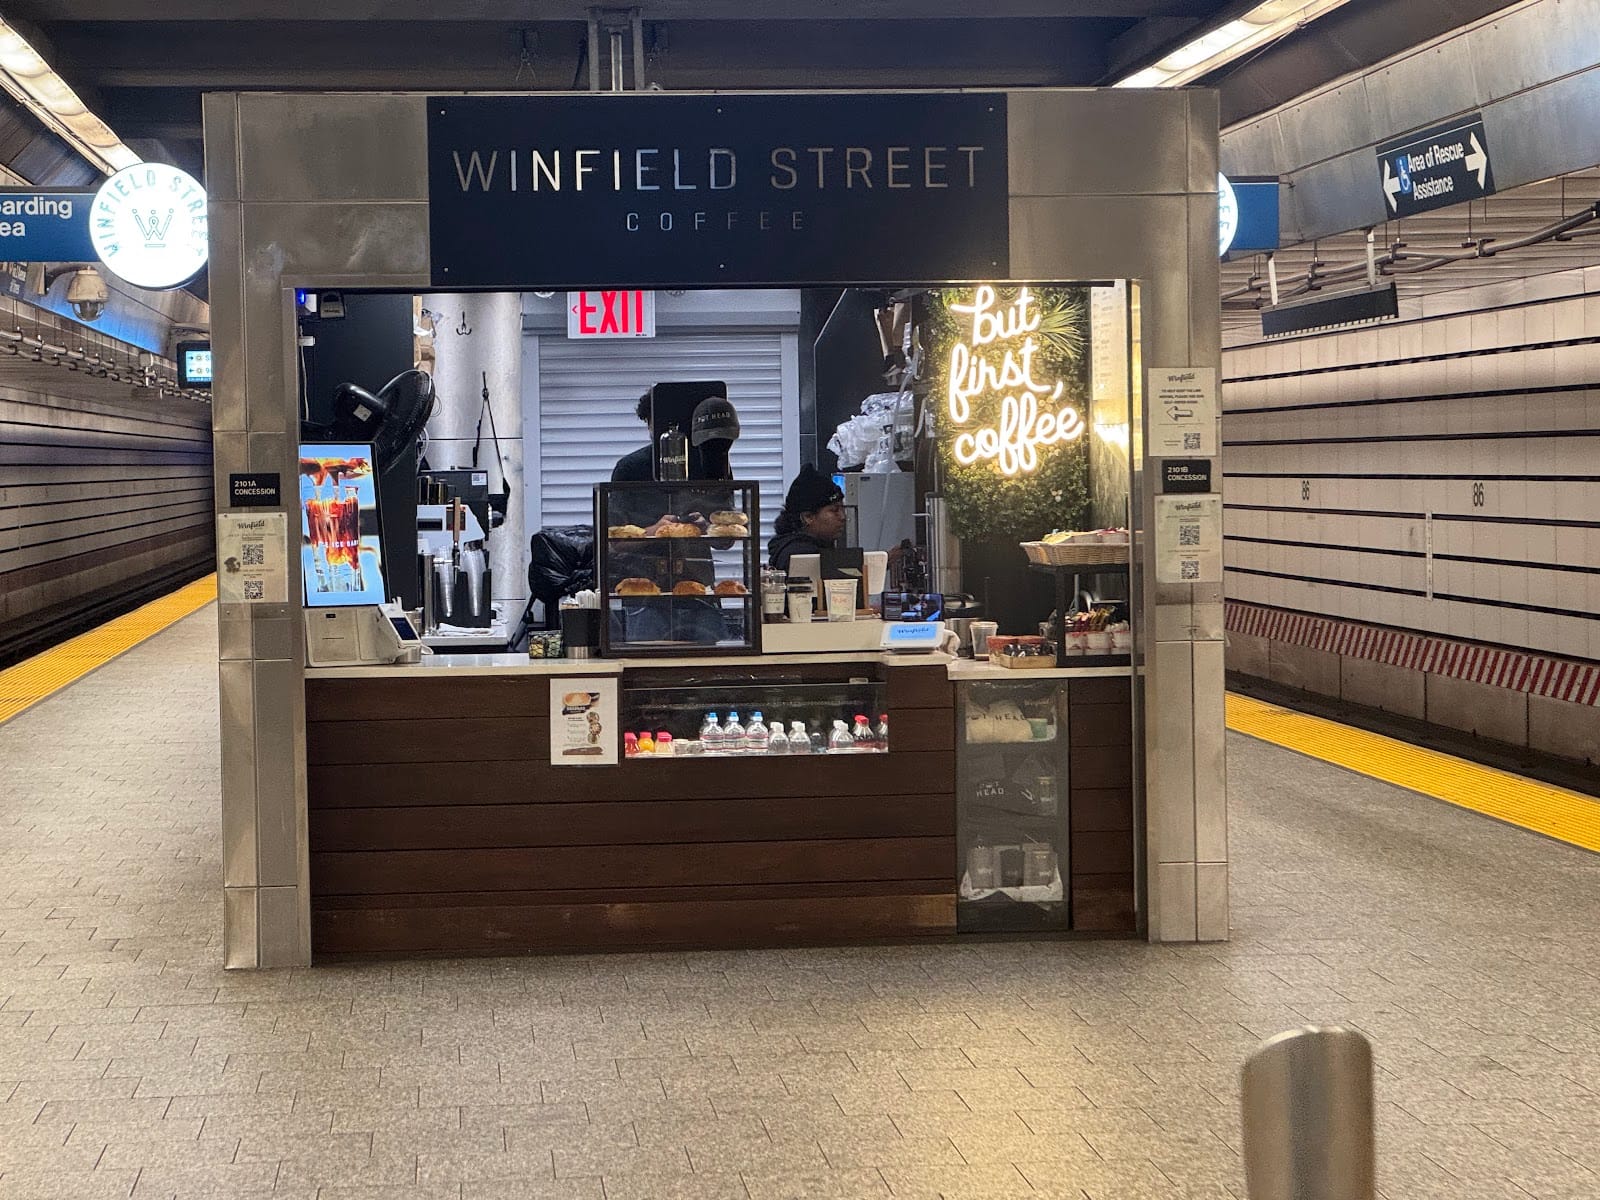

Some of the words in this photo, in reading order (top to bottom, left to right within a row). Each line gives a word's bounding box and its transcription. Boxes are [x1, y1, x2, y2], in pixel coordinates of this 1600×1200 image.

[452, 148, 738, 192] WINFIELD
[770, 146, 984, 189] STREET
[1407, 153, 1426, 173] Area
[1425, 147, 1434, 168] of
[1433, 142, 1465, 165] Rescue
[1412, 176, 1454, 200] Assistance
[0, 196, 73, 219] arding
[96, 169, 156, 257] WINFIELD
[626, 210, 804, 231] COFFEE
[950, 283, 1041, 346] but
[949, 336, 1064, 423] first,
[954, 391, 1085, 475] coffee
[234, 488, 276, 496] CONCESSION
[1302, 480, 1310, 501] 86
[1472, 482, 1485, 507] 86
[236, 520, 265, 529] Winfield
